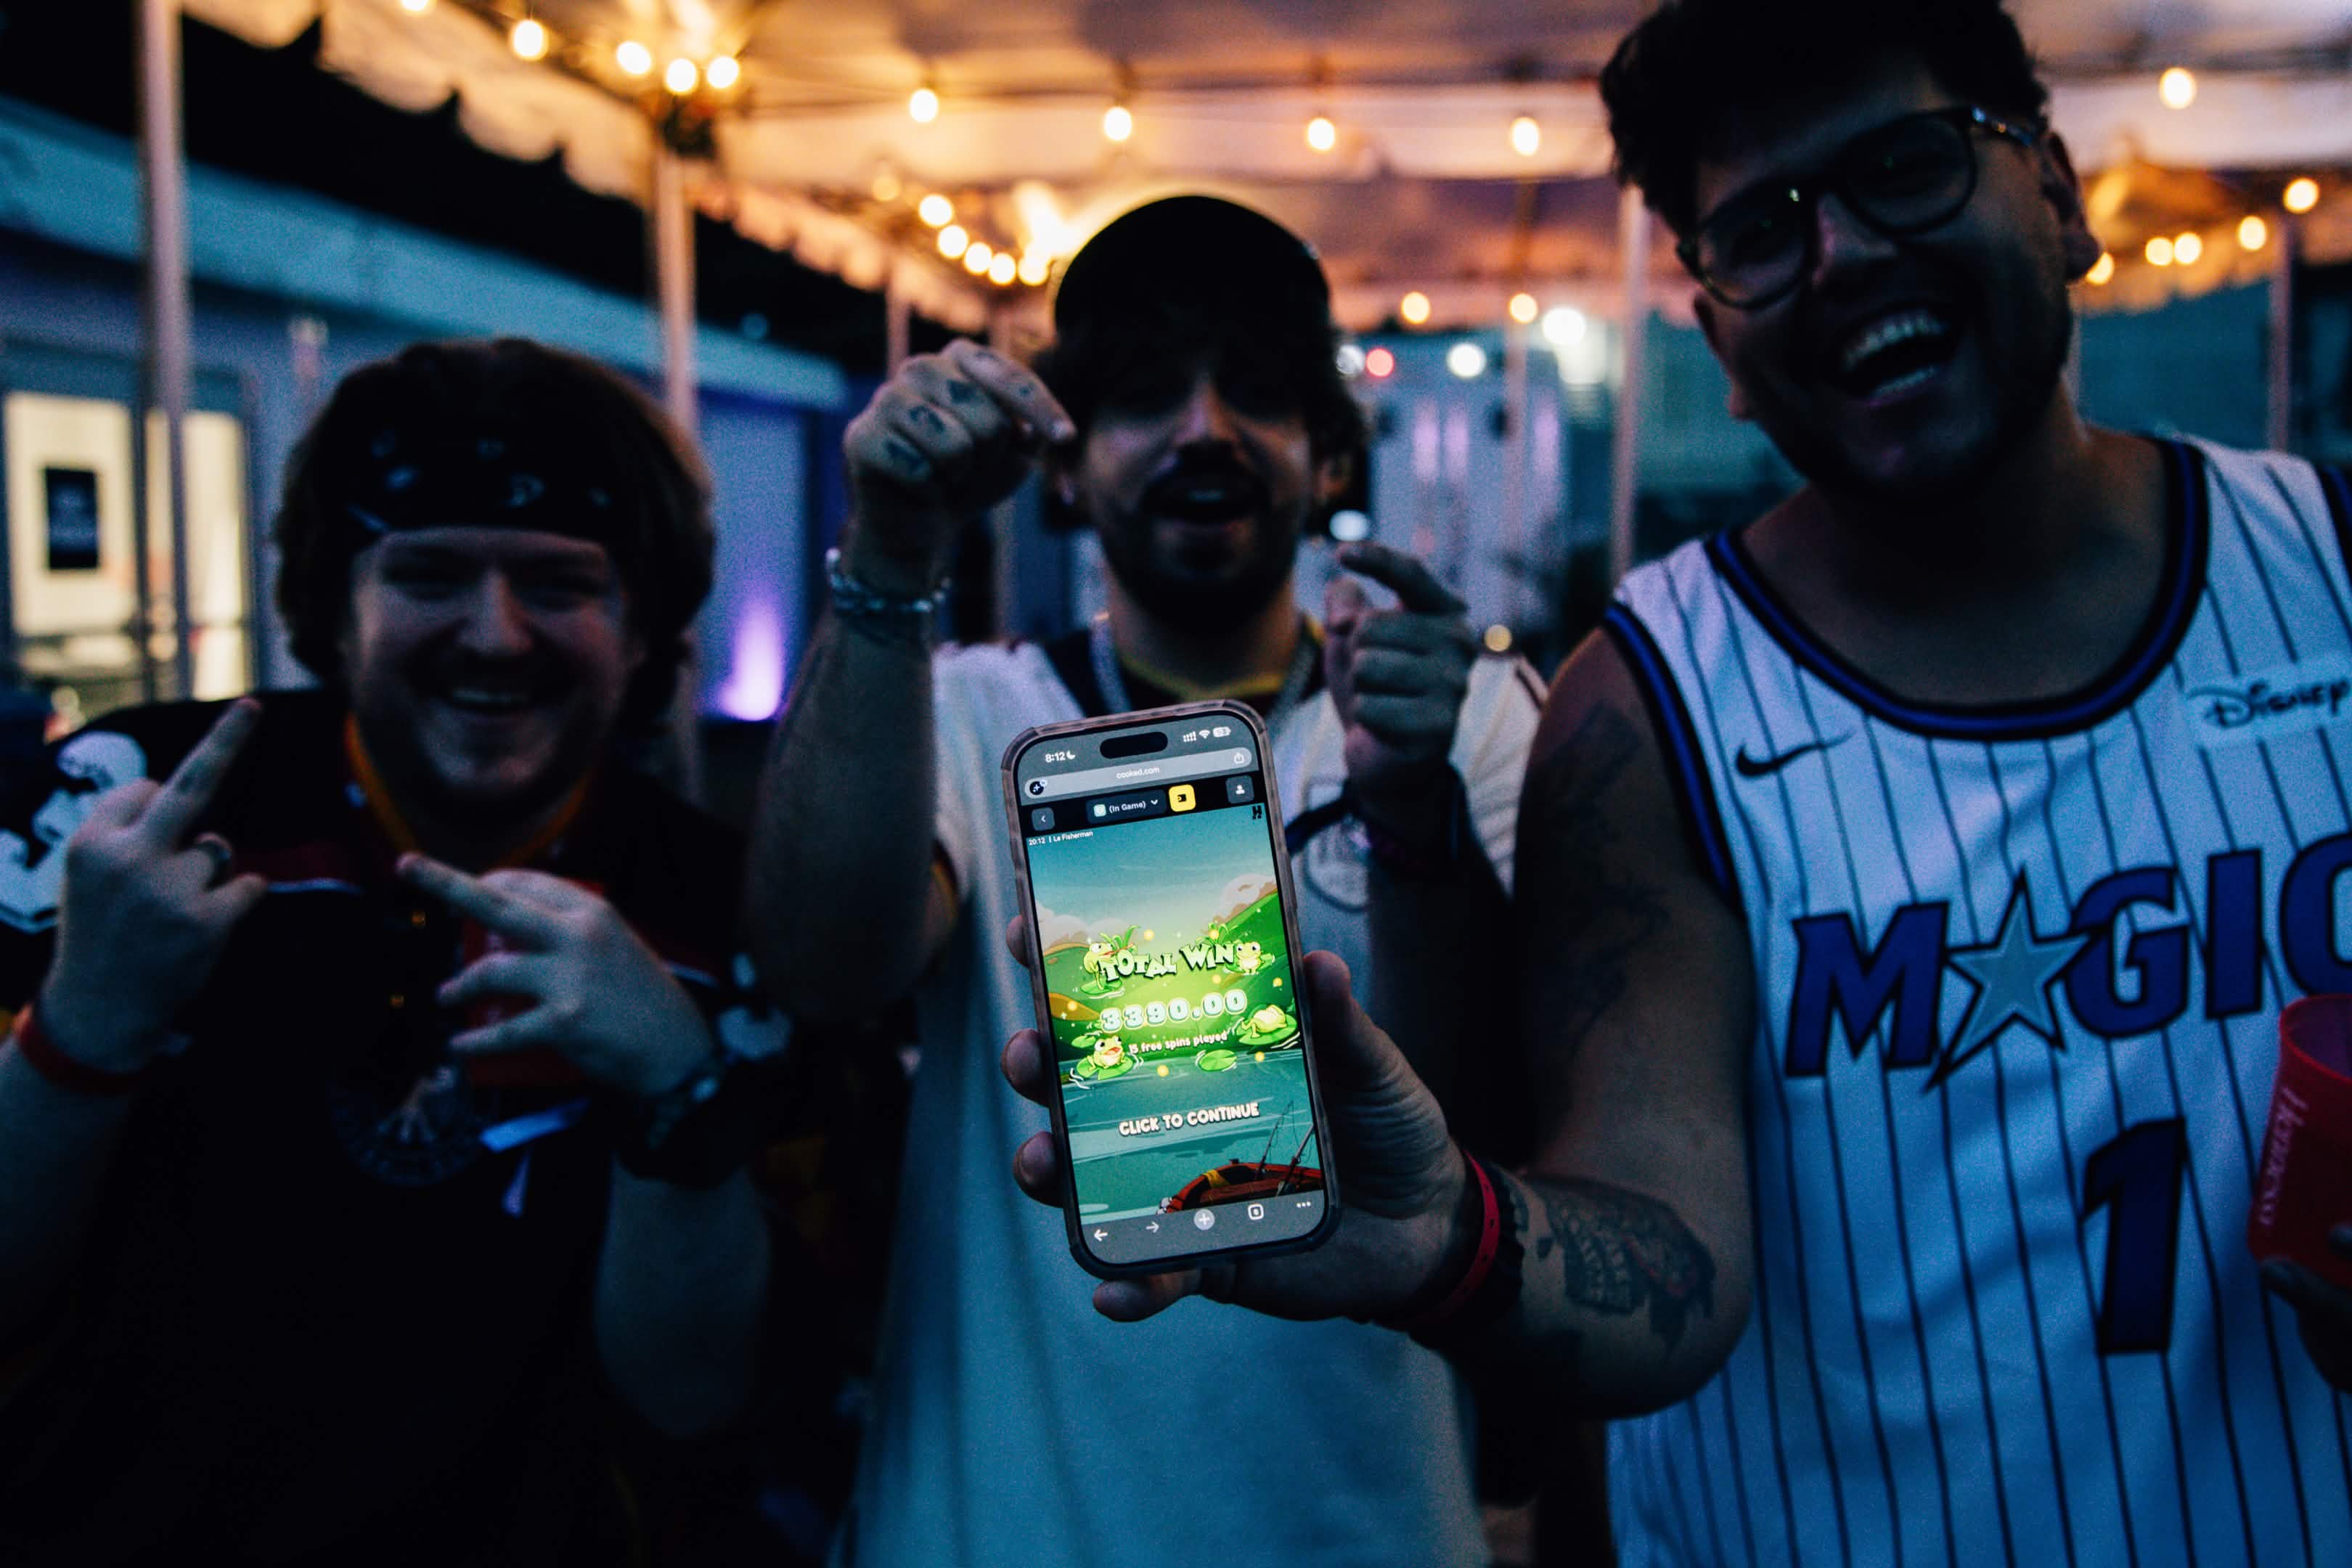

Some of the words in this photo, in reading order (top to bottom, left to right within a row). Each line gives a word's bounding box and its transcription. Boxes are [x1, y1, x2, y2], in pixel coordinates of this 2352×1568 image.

[2186, 679, 2351, 729] Disney
[1045, 751, 1066, 763] 8:12
[1116, 766, 1160, 780] cooked.com
[1122, 801, 1146, 812] Game)
[1062, 830, 1094, 841] Fisherman
[1098, 950, 1177, 981] TOTAL
[1179, 943, 1235, 971] WIN
[1100, 989, 1248, 1034] 3390.00
[1128, 1043, 1139, 1054] 15
[1141, 1042, 1163, 1053] free
[1164, 1037, 1191, 1050] spins
[1193, 1029, 1228, 1047] played
[1119, 1118, 1161, 1137] CLICK
[1162, 1114, 1183, 1130] TO
[1186, 1102, 1260, 1126] CONTINUE
[2081, 1115, 2186, 1357] 1
